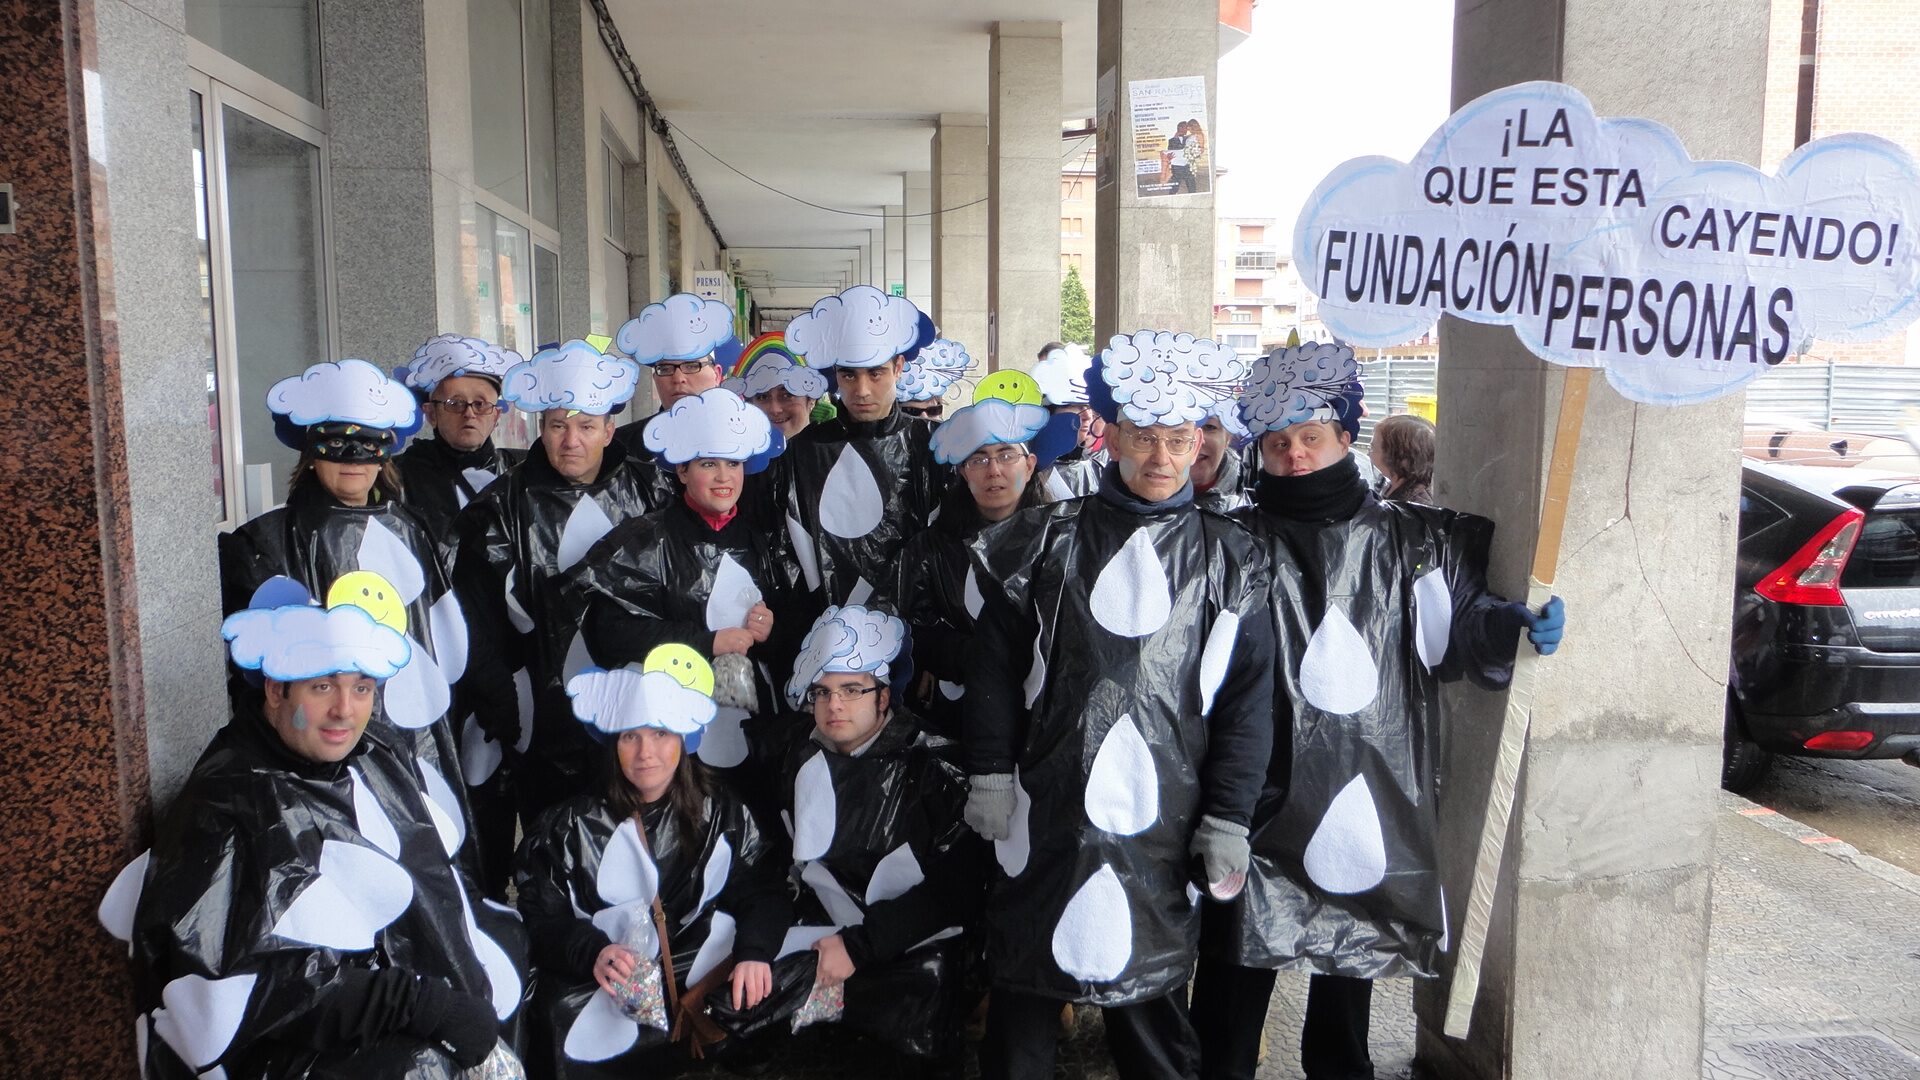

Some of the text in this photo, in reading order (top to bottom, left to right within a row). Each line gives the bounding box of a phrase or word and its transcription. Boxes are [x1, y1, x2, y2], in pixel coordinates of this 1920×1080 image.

[1501, 108, 1574, 157] ¡LA
[1423, 165, 1647, 208] QUE ESTA
[1661, 204, 1899, 267] CAYENDO!
[696, 277, 721, 287] PRENSA
[1321, 223, 1794, 365] FUNDACIÓN PERSONAS
